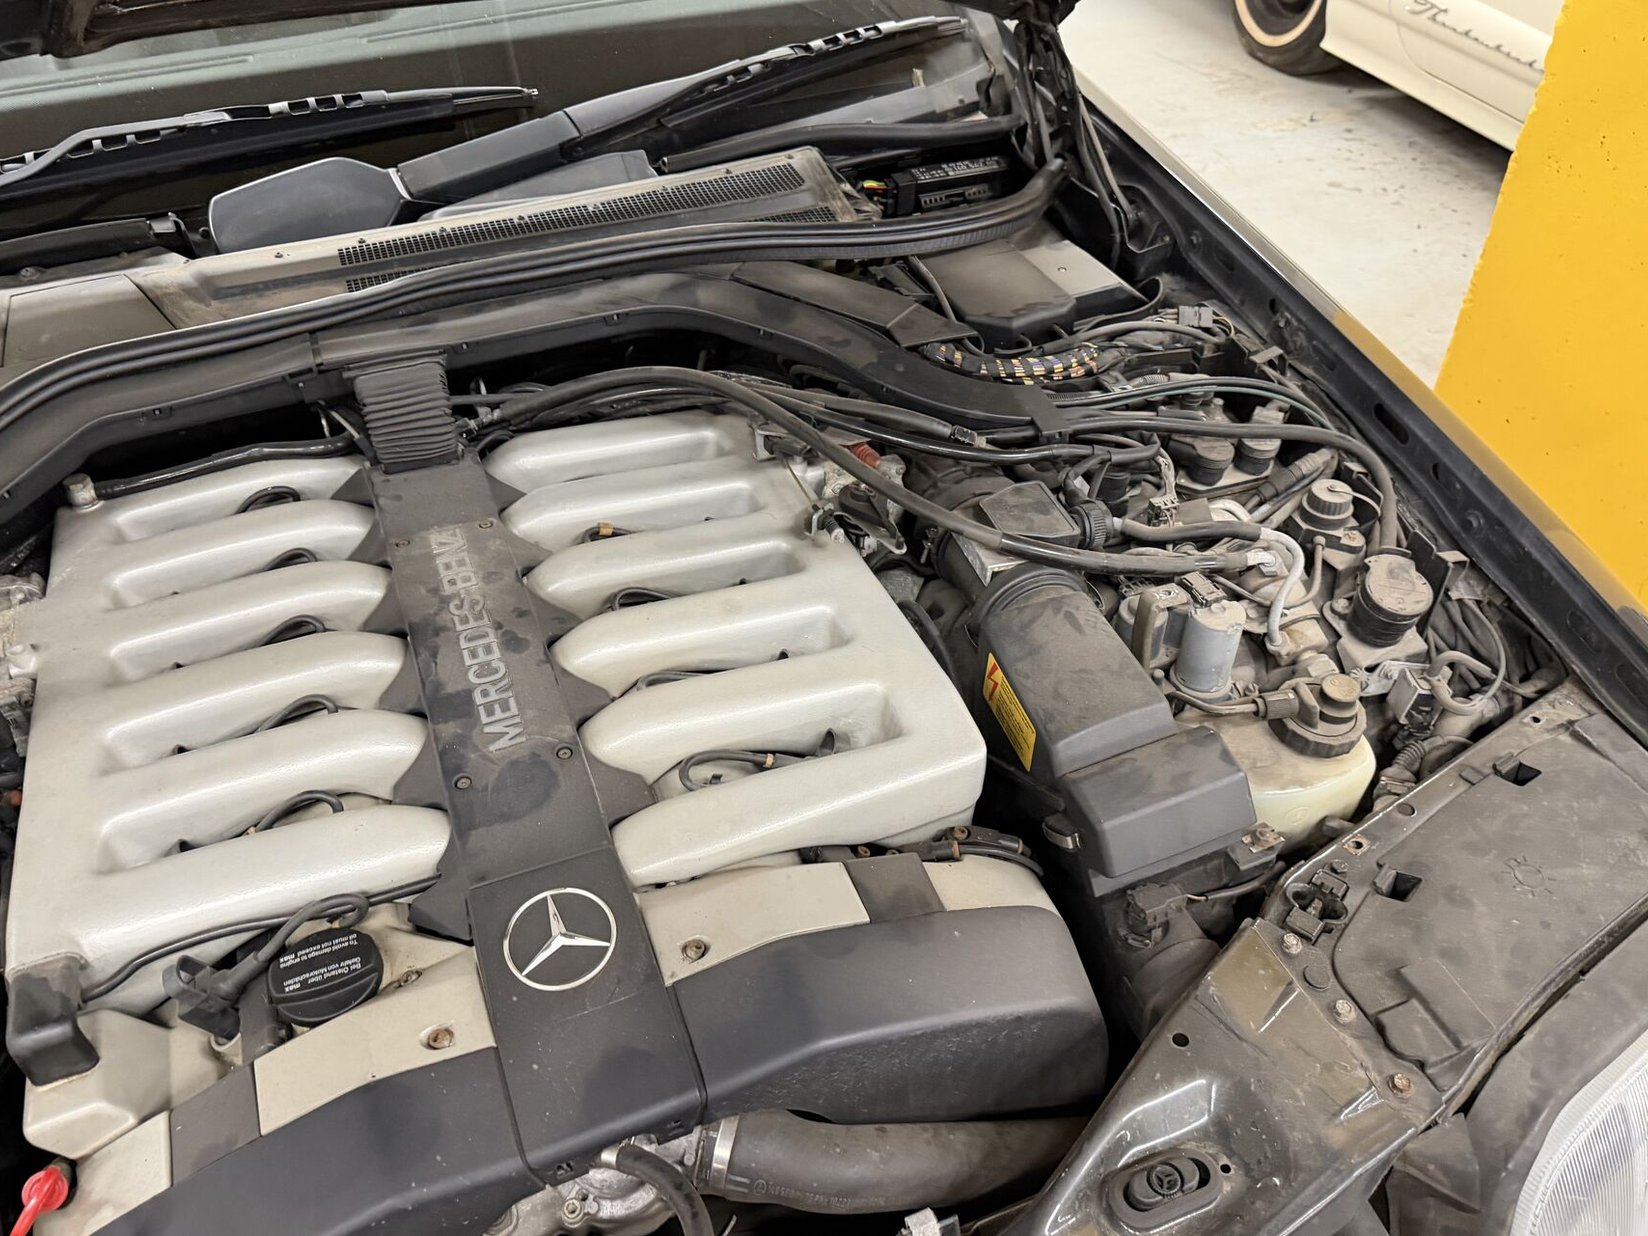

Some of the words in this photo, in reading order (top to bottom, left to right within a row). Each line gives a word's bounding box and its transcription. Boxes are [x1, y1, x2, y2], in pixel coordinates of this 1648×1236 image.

[321, 940, 332, 948] not
[333, 936, 349, 945] must
[297, 944, 321, 957] exceed
[332, 942, 348, 952] avoid
[308, 947, 331, 958] damage
[280, 953, 295, 963] max
[280, 957, 300, 968] engine
[328, 963, 339, 971] von
[285, 983, 300, 992] max
